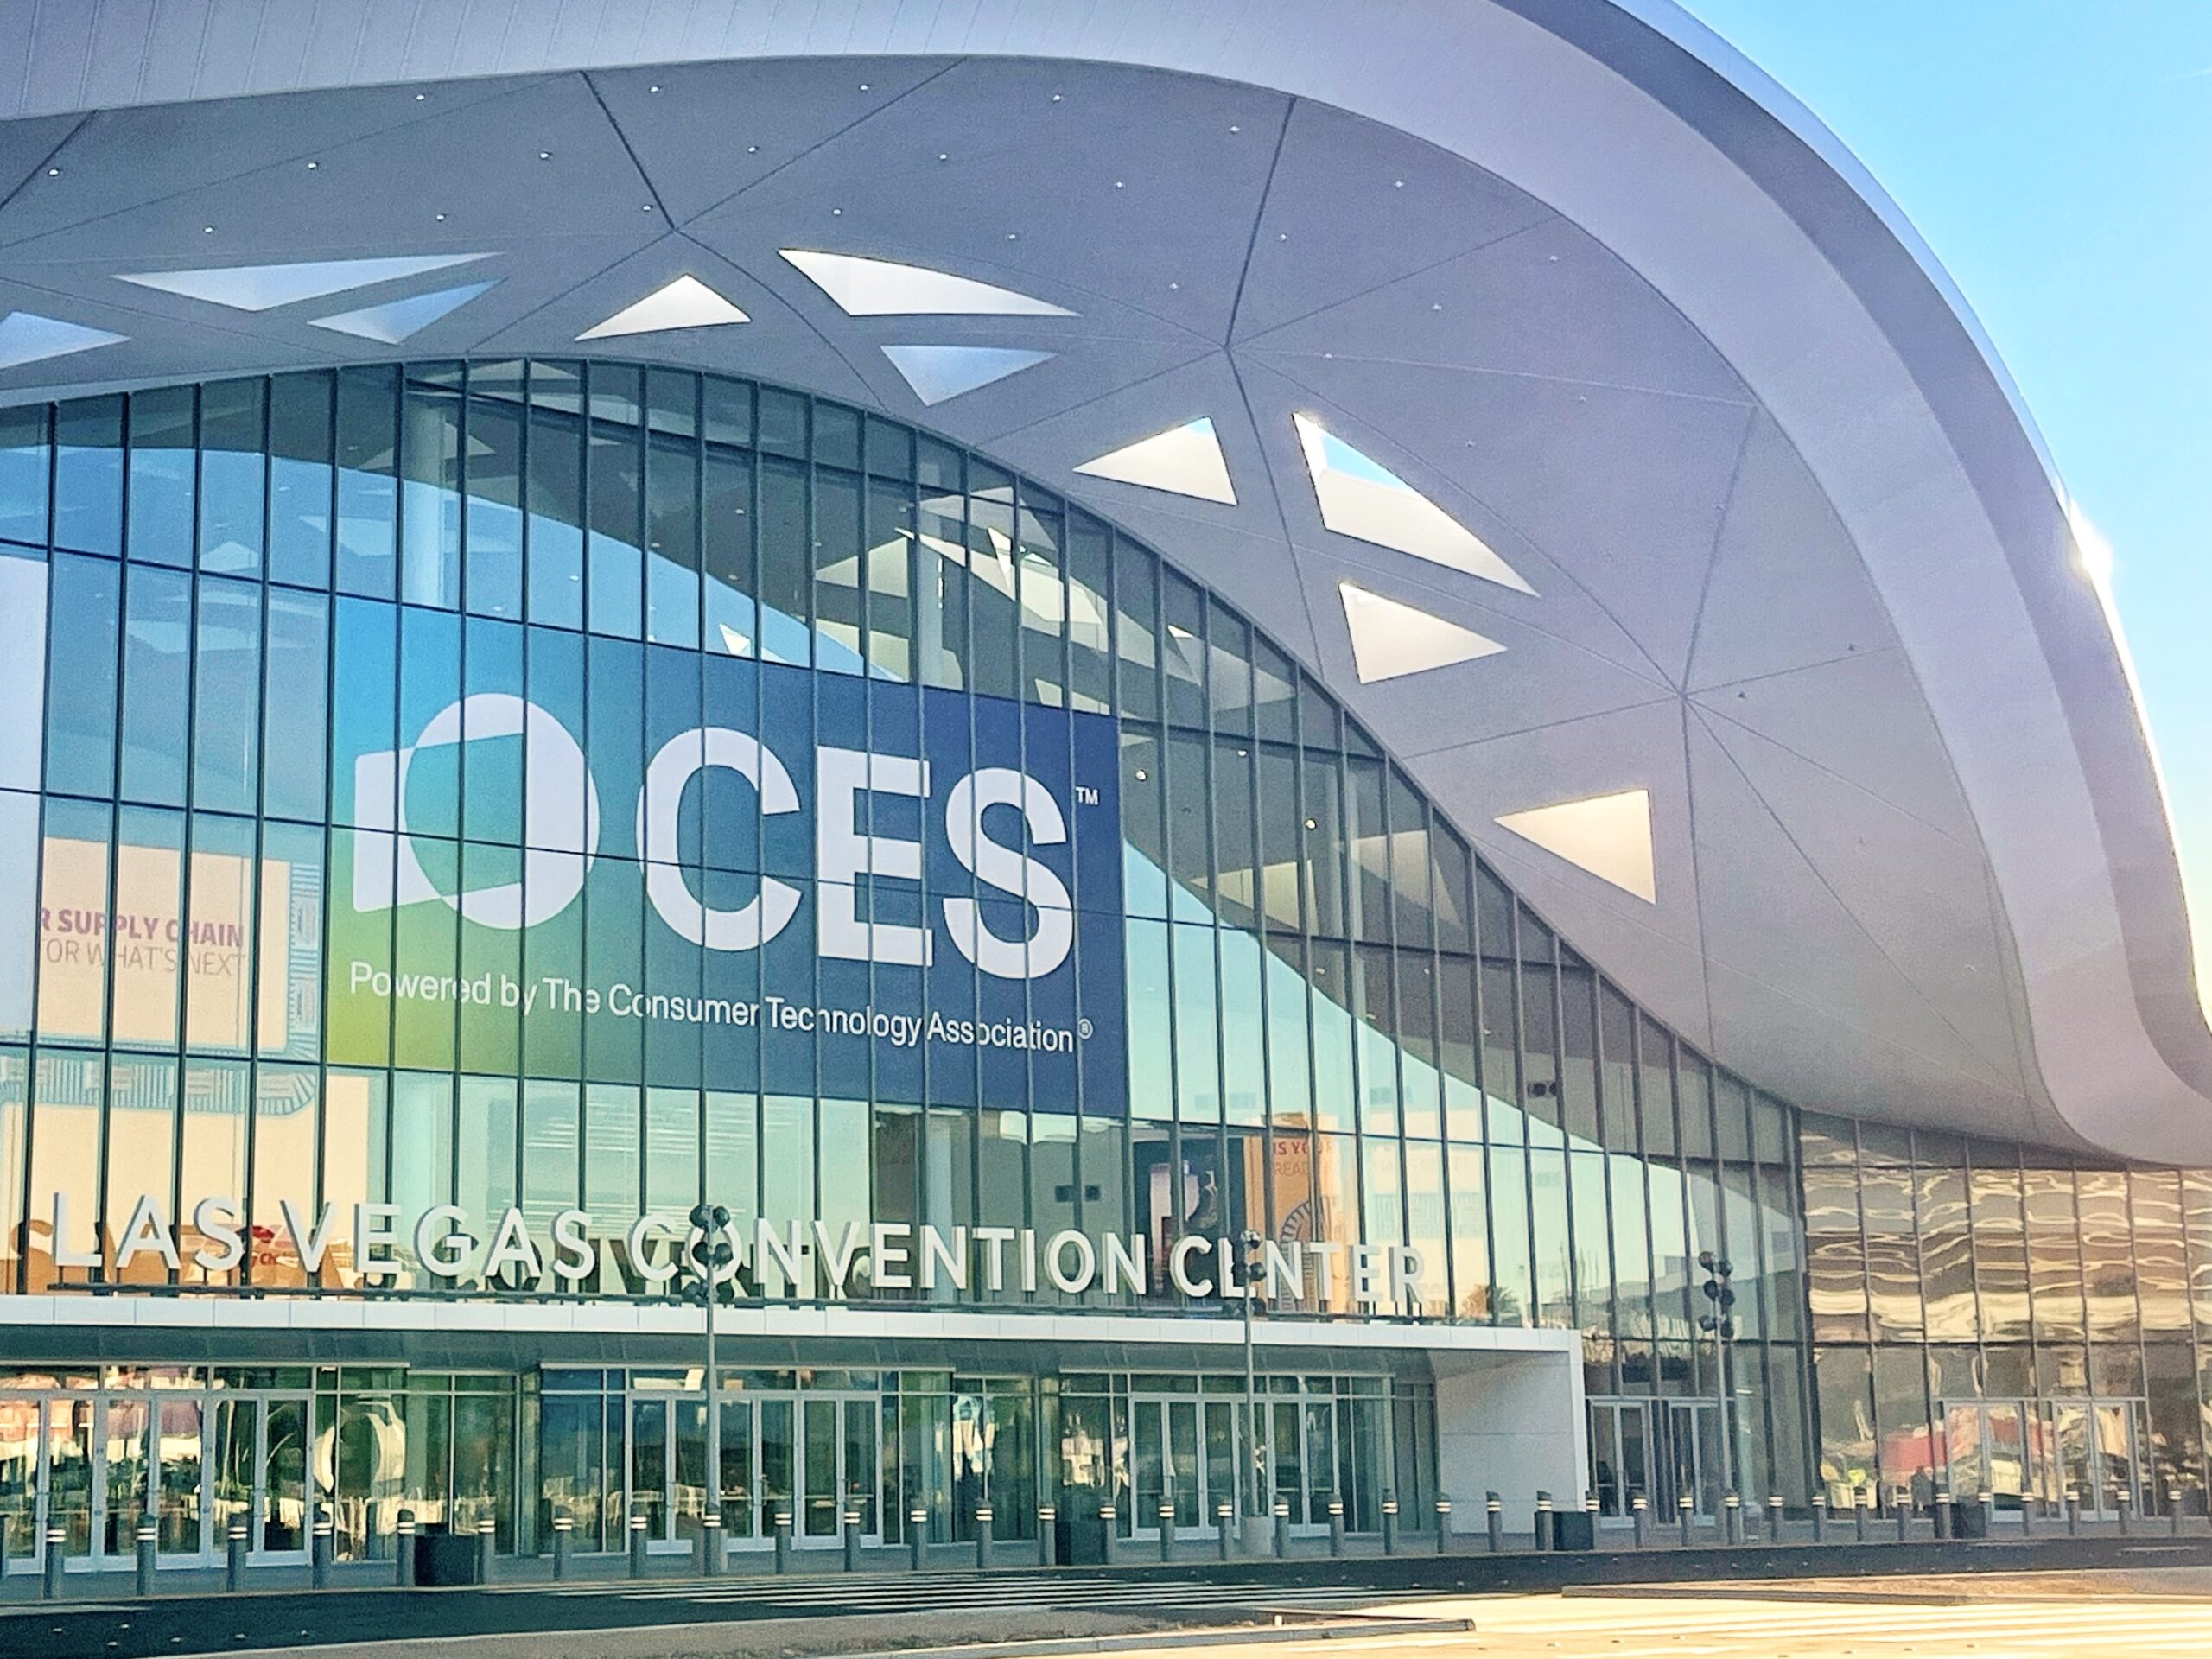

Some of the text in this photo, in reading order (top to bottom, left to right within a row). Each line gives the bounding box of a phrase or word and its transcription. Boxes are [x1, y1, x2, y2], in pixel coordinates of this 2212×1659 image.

[636, 727, 1074, 979] CES
[57, 908, 159, 939] SUPPLY
[349, 961, 491, 1005] Powered
[500, 974, 537, 1016] by
[543, 977, 601, 1014] The
[608, 983, 760, 1027] Consumer
[765, 995, 922, 1047] Technology
[54, 1192, 245, 1270] LAS
[280, 1199, 596, 1280] VEGAS
[628, 1212, 1147, 1294] CONVENTION
